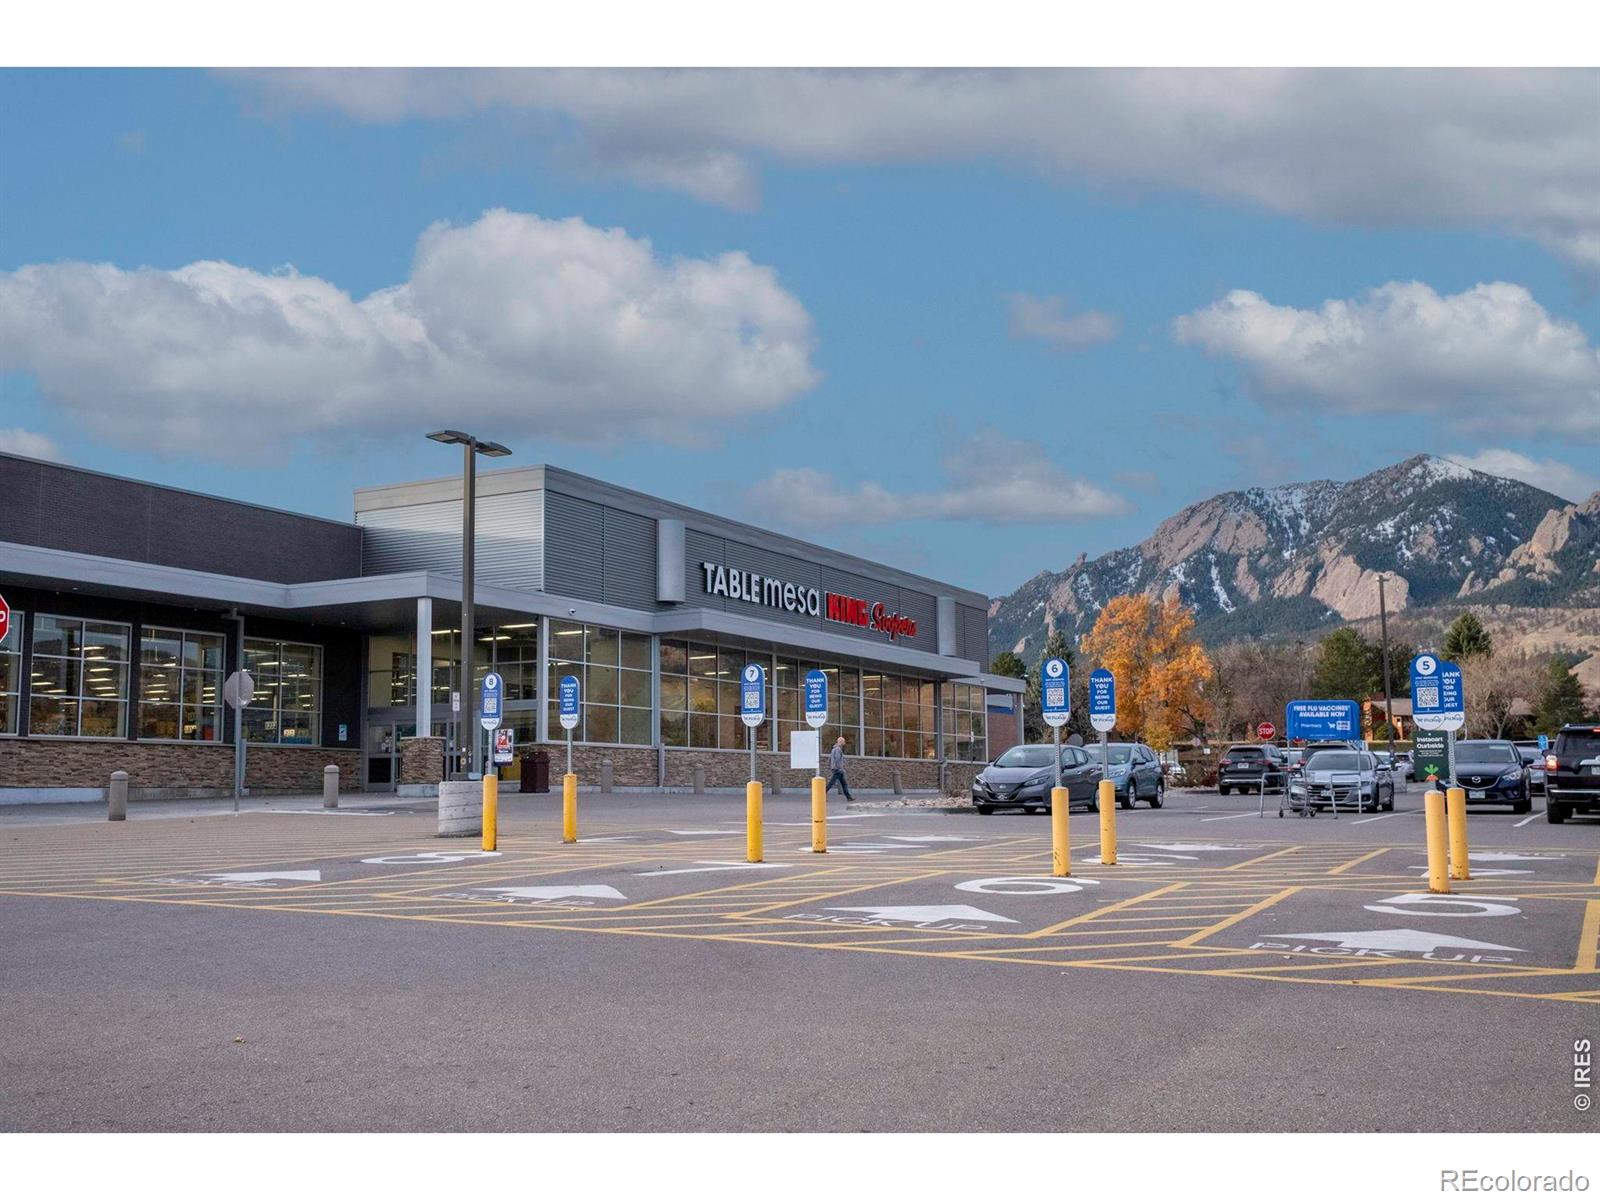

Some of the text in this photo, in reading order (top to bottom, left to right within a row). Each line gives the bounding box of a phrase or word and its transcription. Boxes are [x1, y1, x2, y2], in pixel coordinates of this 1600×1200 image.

[703, 562, 820, 617] TABLE mesa
[825, 591, 869, 628] KING
[749, 669, 755, 678] 7
[1051, 664, 1058, 673] 6
[1422, 660, 1430, 670] 5
[954, 876, 1101, 895] 6
[1363, 892, 1522, 917] 5
[783, 913, 988, 930] PICK UP
[1249, 942, 1514, 963] PICK UP
